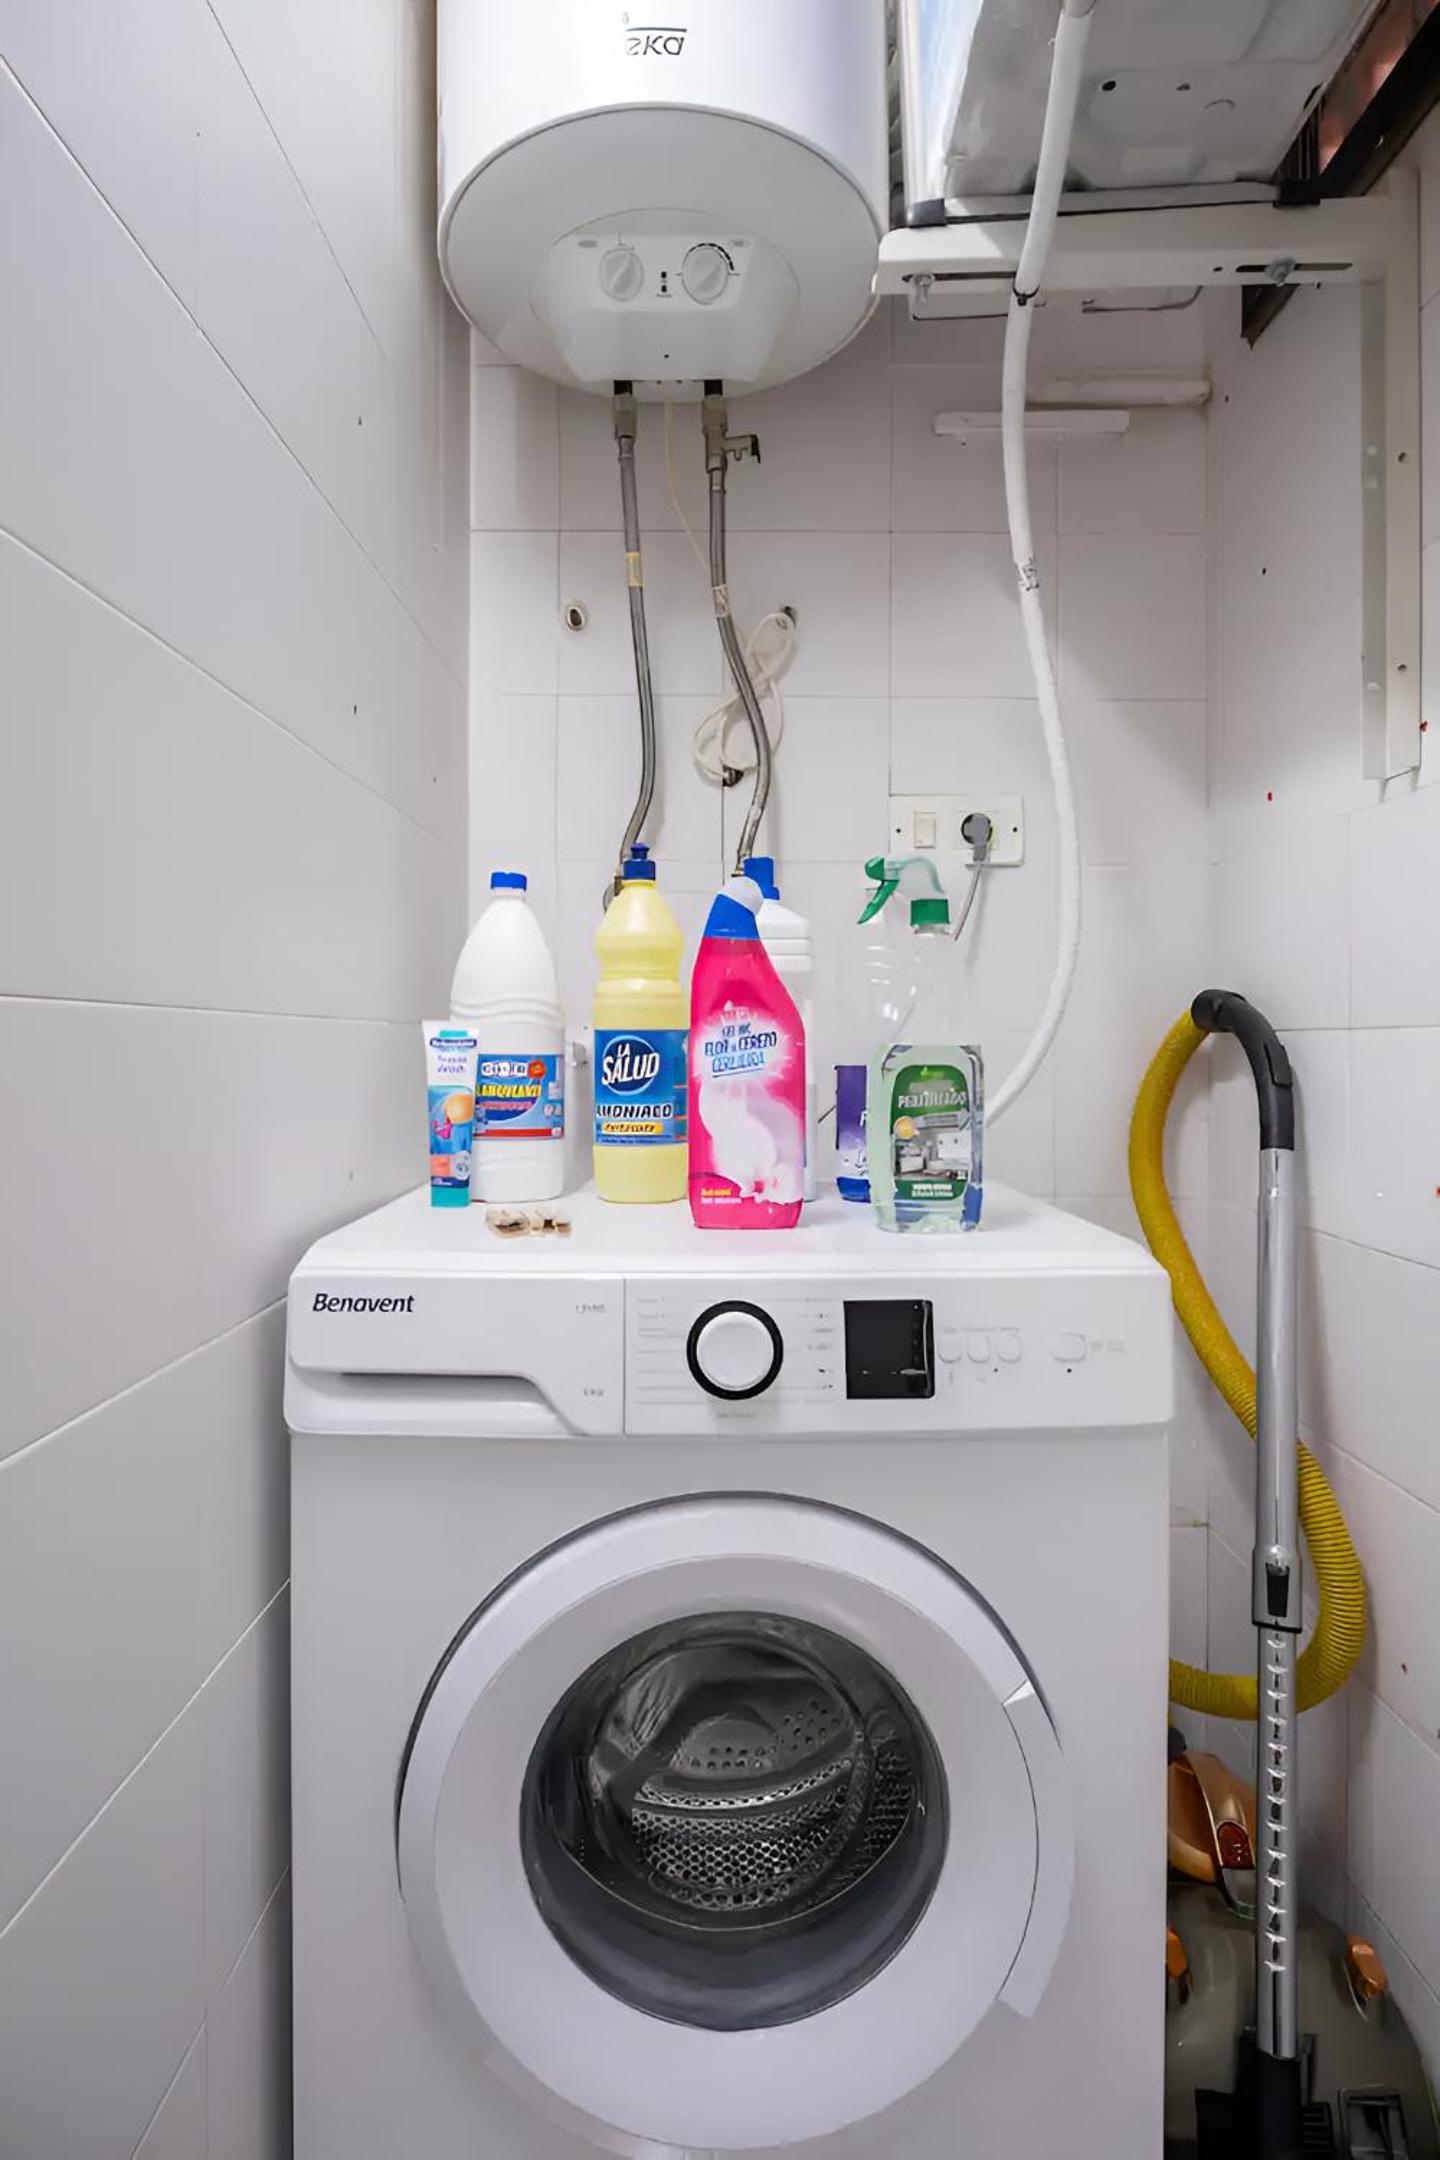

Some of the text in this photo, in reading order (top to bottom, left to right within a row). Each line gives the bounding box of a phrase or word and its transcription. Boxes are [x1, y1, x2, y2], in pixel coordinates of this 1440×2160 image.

[617, 1043, 631, 1057] LA
[601, 1053, 660, 1085] SALUD
[312, 1292, 415, 1313] Benavent
